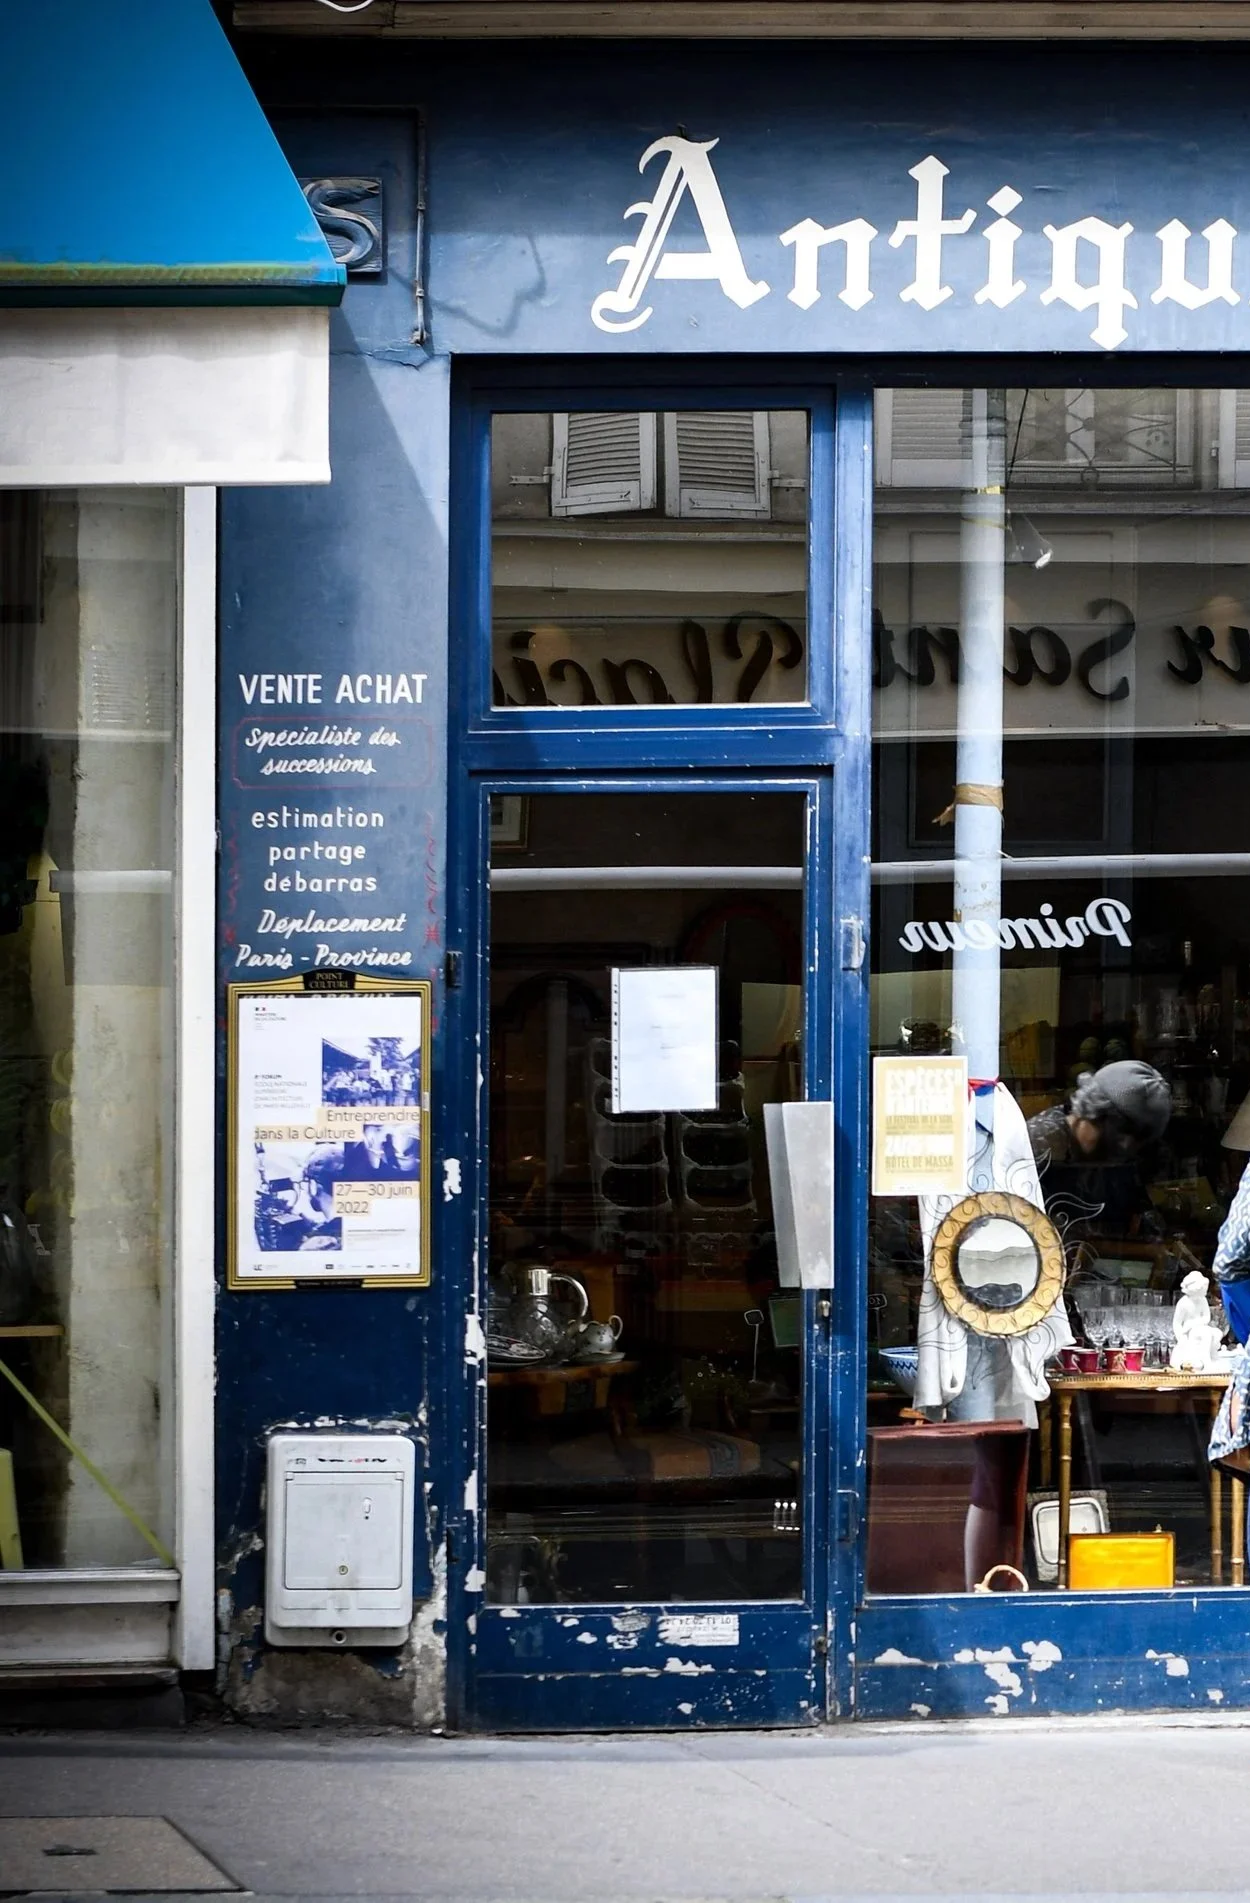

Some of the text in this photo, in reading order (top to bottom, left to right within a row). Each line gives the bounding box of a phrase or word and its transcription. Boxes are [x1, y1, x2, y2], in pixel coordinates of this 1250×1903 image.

[239, 674, 427, 705] VENTE ACHAT
[245, 725, 401, 753] Spécialiste des
[261, 753, 377, 775] successions
[251, 806, 384, 829] estimation
[269, 841, 366, 865] partage
[263, 871, 377, 893] débarras
[257, 909, 407, 939] Déplacement
[235, 944, 293, 969] Paris
[314, 944, 412, 967] Province
[316, 972, 344, 980] POINT
[327, 1110, 420, 1126] Entreprendre
[288, 1127, 299, 1140] la
[304, 1127, 356, 1140] Culture
[387, 1183, 412, 1199] juin
[336, 1202, 369, 1214] 2022
